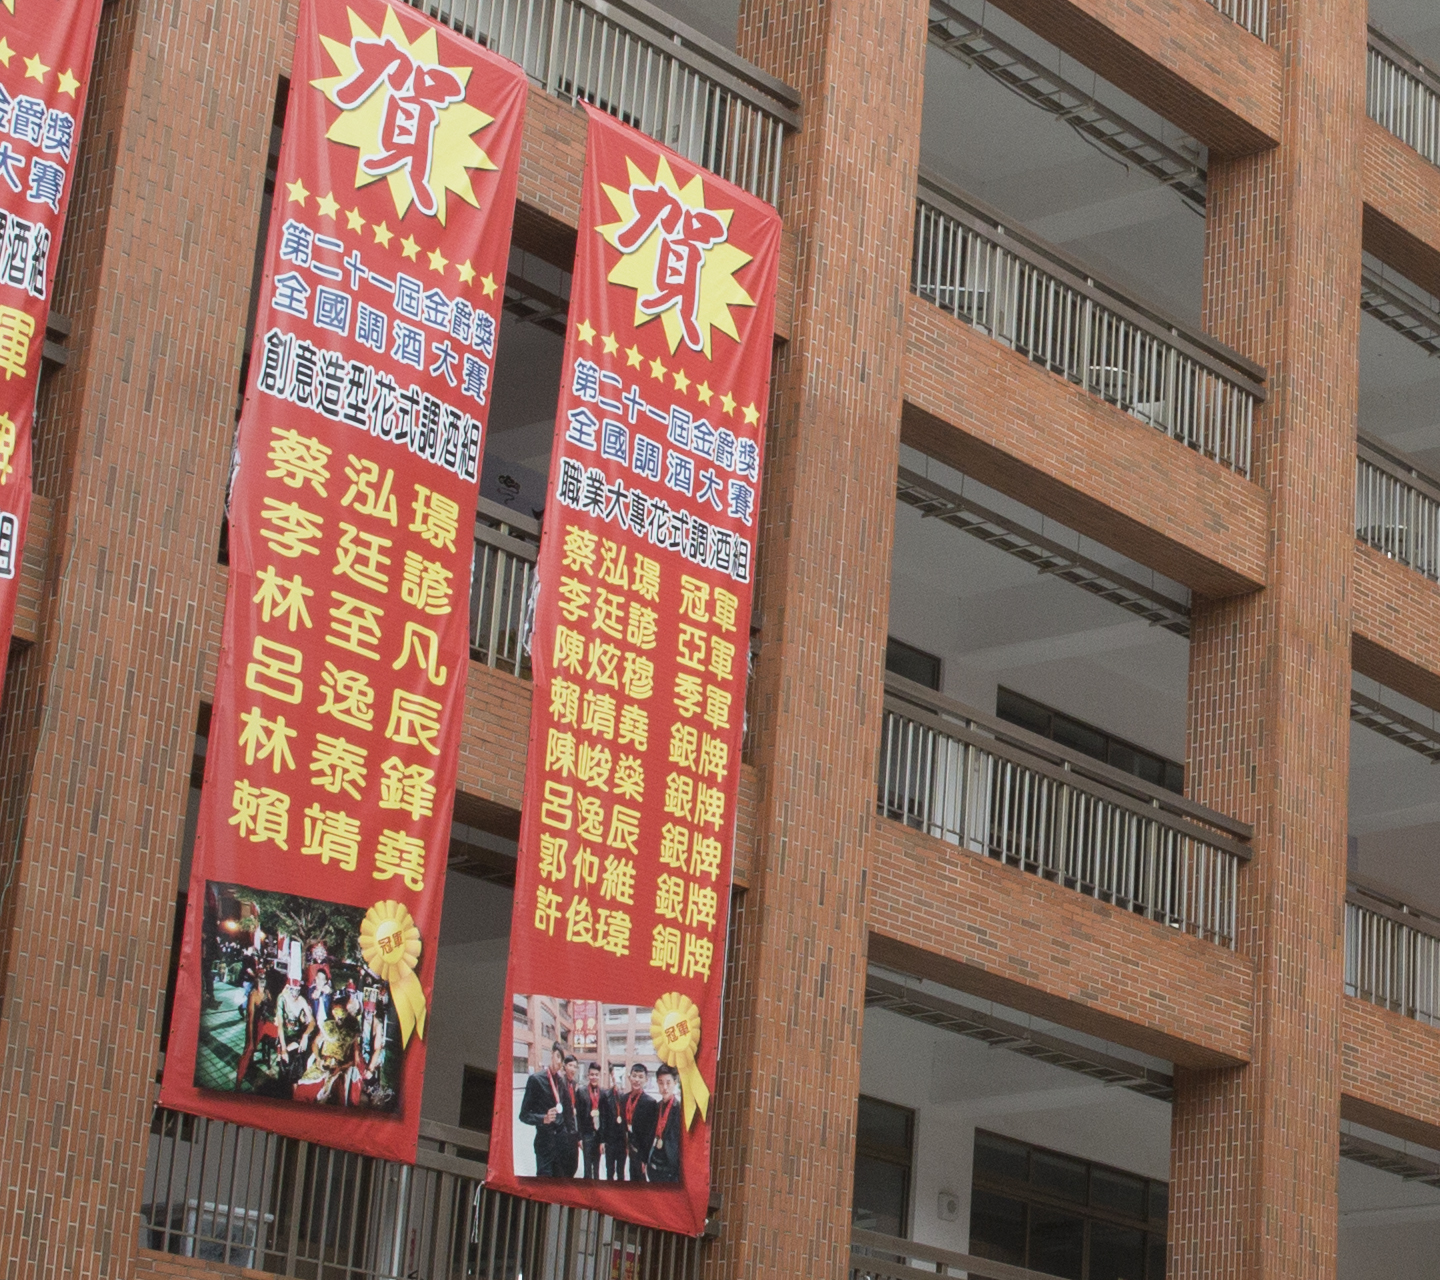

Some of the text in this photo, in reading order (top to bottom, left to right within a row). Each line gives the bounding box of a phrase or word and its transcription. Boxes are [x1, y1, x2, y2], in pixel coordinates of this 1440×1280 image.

[332, 35, 466, 215] 賀
[280, 219, 497, 359] 第二十一屆金爵獎
[615, 181, 728, 351] 賀
[272, 271, 489, 406] 全國調酒大賽
[257, 327, 482, 484] 創意造型花式調酒組
[573, 357, 759, 482] 第二十一屆金爵獎
[557, 457, 751, 584] 職業大專花式調酒組
[566, 407, 754, 526] 全國調酒大賽
[260, 497, 453, 615] 李廷諺
[678, 574, 739, 634] 冠軍
[253, 565, 447, 686] 林至凡
[558, 576, 736, 682] 李廷諺 亞軍
[246, 635, 442, 756] 呂逸辰
[668, 721, 728, 783] 銀牌
[673, 671, 732, 730] 季軍
[238, 706, 437, 821] 林泰鋒
[663, 771, 726, 832] 銀牌
[540, 780, 723, 883] 呂逸辰 銀牌
[649, 924, 714, 984] 銅牌
[654, 872, 718, 933] 銀牌
